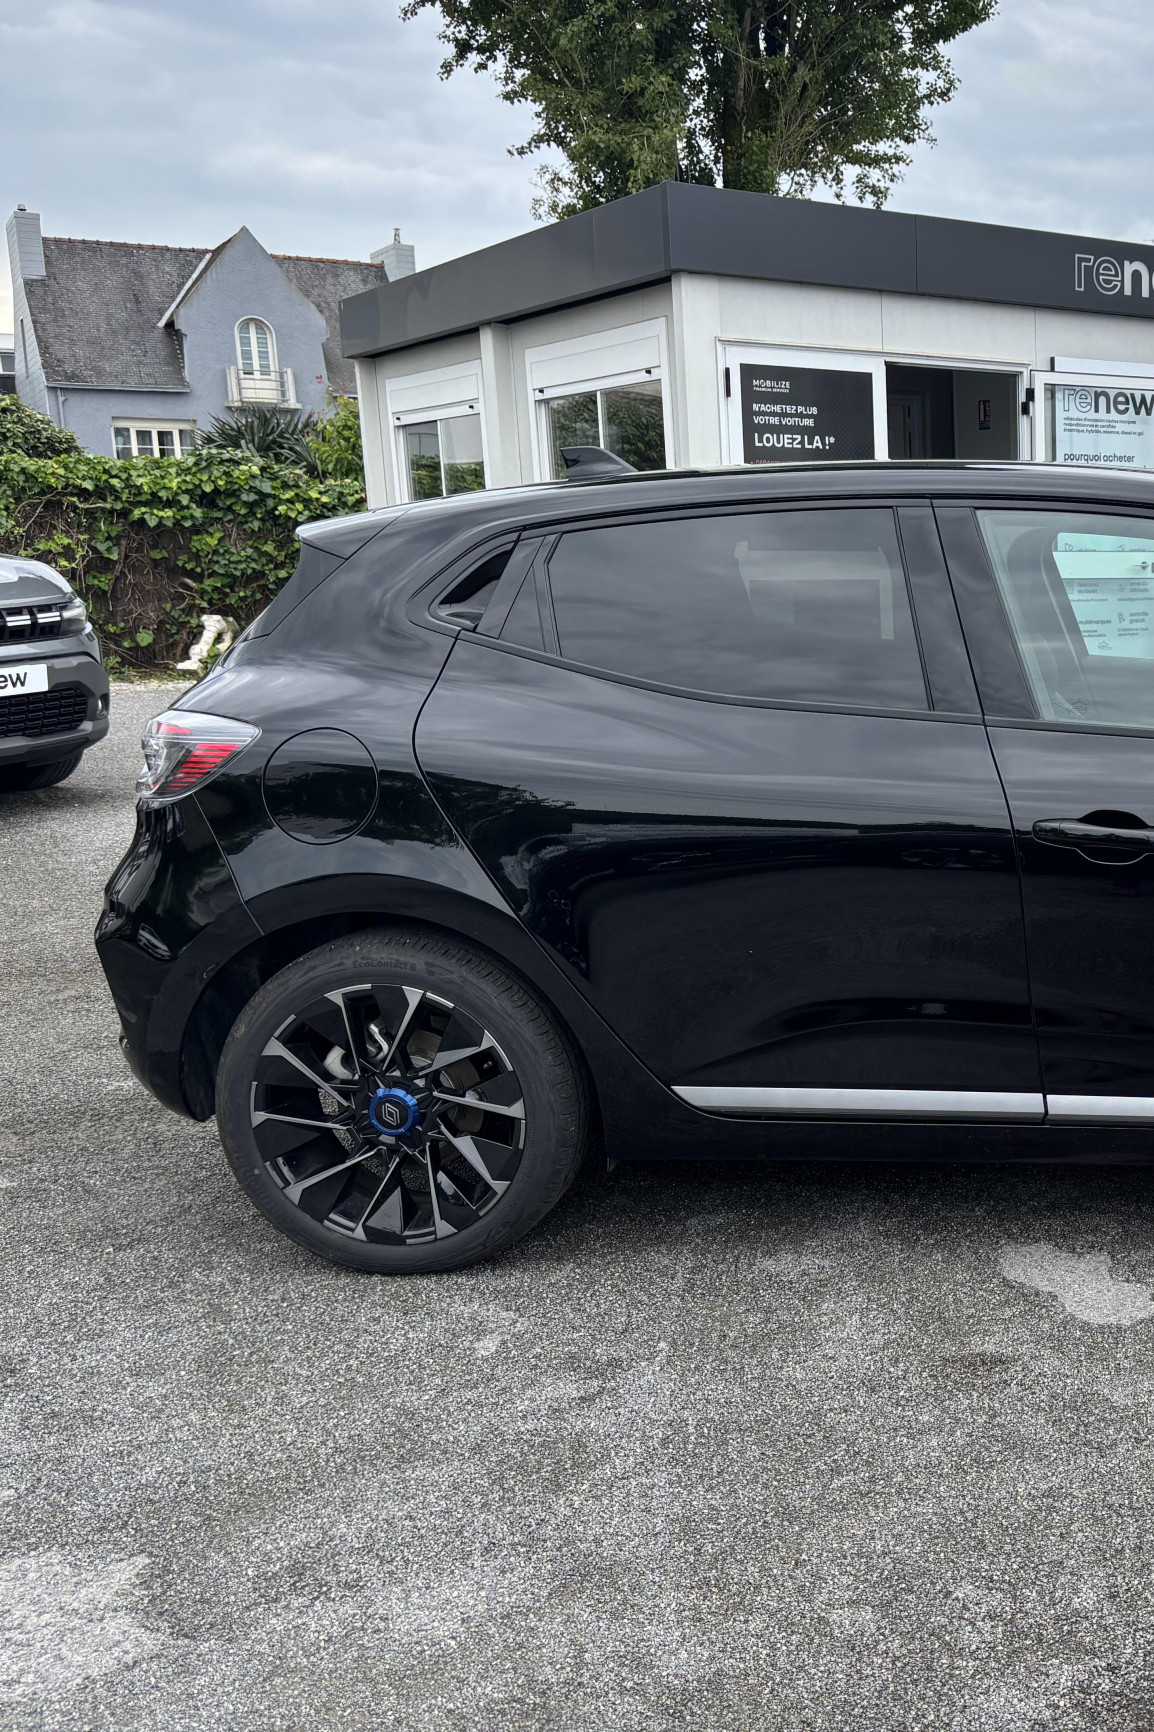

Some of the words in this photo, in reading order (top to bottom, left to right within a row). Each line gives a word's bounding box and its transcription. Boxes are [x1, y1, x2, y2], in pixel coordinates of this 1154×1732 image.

[752, 379, 790, 389] MOBILIZE
[1063, 388, 1154, 416] renew
[752, 403, 796, 414] N'ACHETEZ
[797, 406, 818, 415] PLUS
[753, 415, 780, 425] VOTRE
[781, 417, 815, 426] VOITURE
[754, 433, 802, 448] LOUEZ
[804, 435, 823, 450] LA
[1063, 452, 1102, 463] pourquoi
[1102, 453, 1135, 463] acheter
